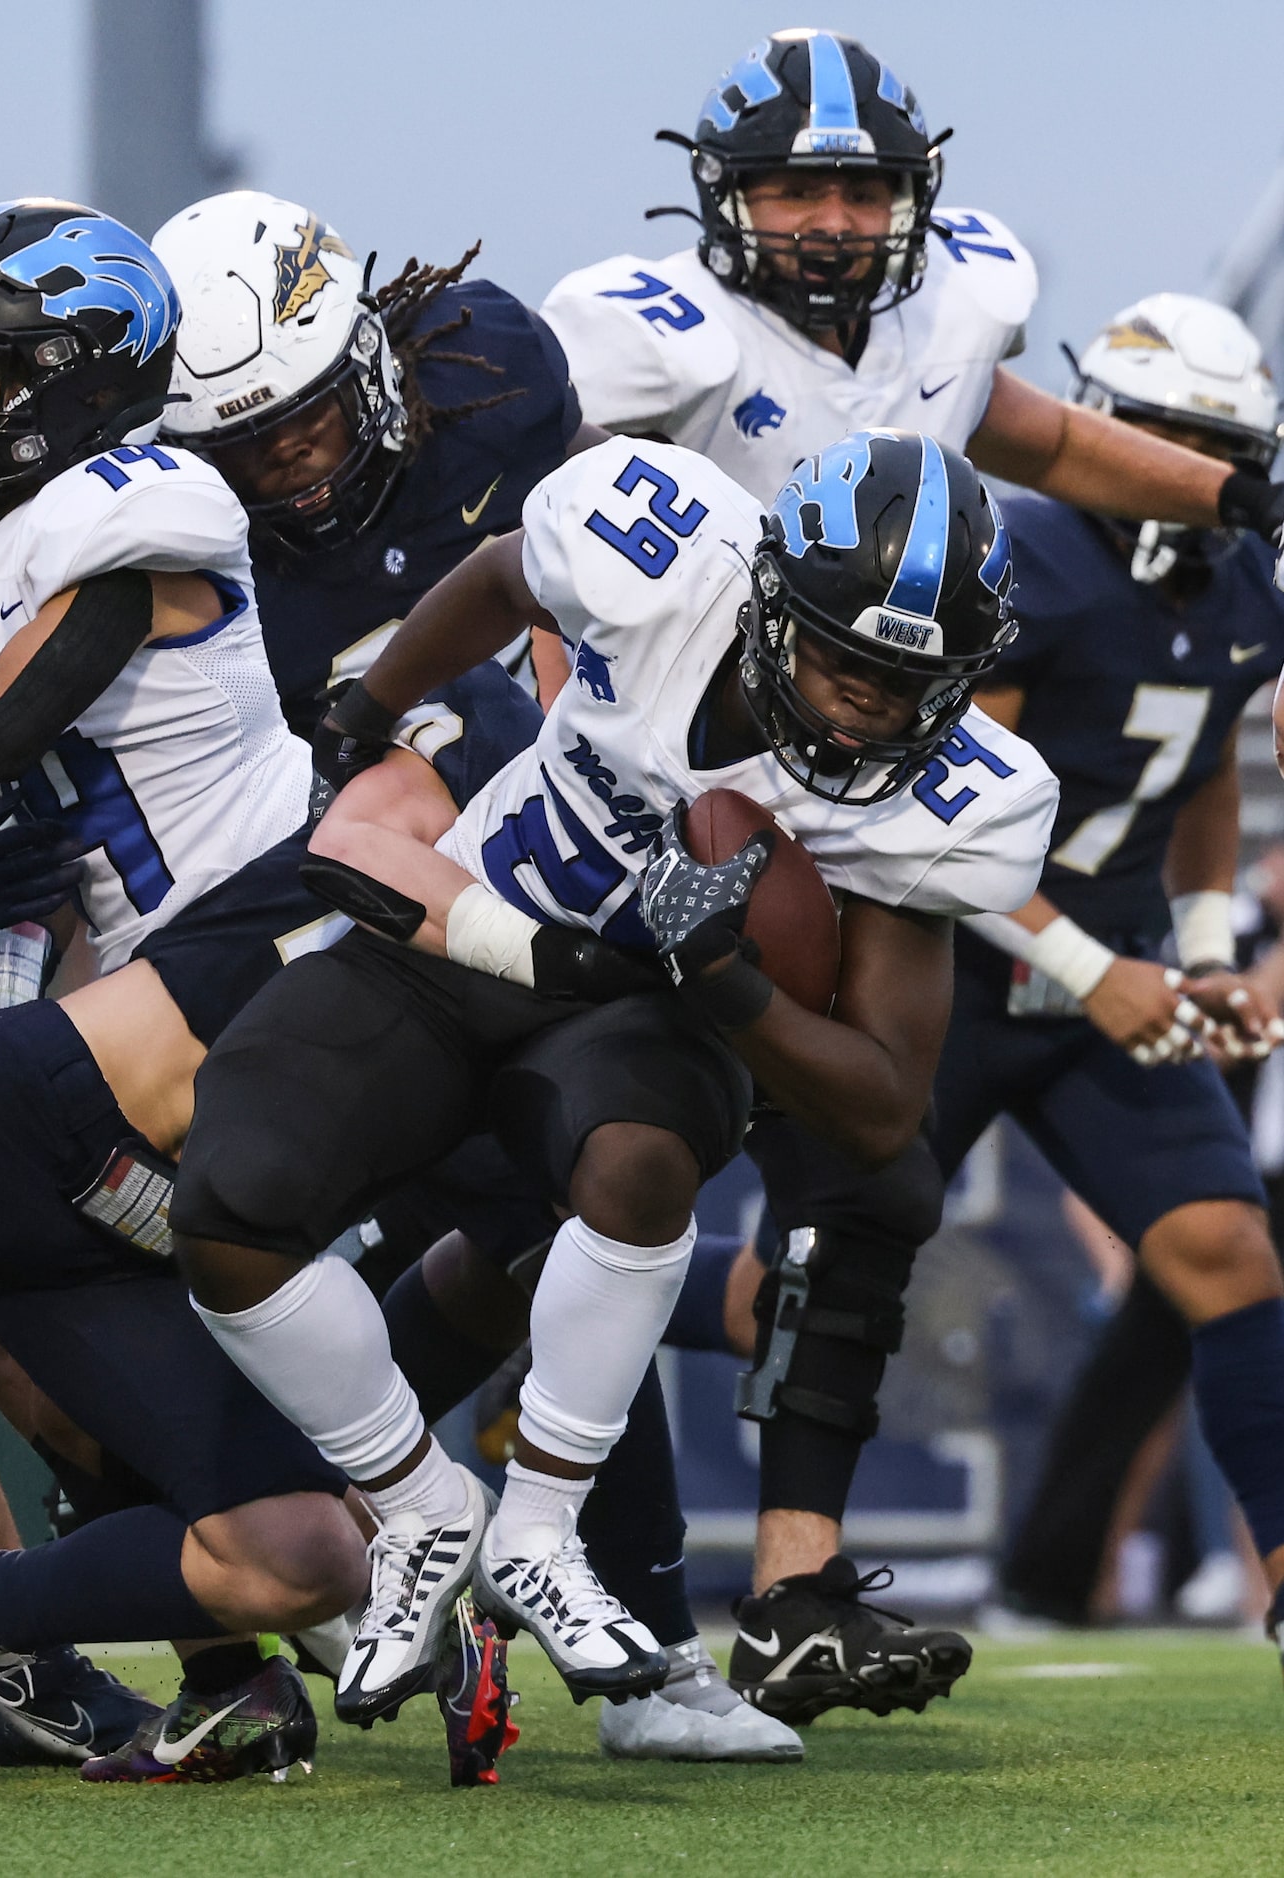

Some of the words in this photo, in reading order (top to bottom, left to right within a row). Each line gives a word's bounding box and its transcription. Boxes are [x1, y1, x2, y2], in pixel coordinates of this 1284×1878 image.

[595, 270, 706, 338] 72
[214, 384, 276, 421] KELLER
[84, 443, 181, 492] 14
[875, 613, 934, 651] WEST
[1049, 681, 1214, 878] 7
